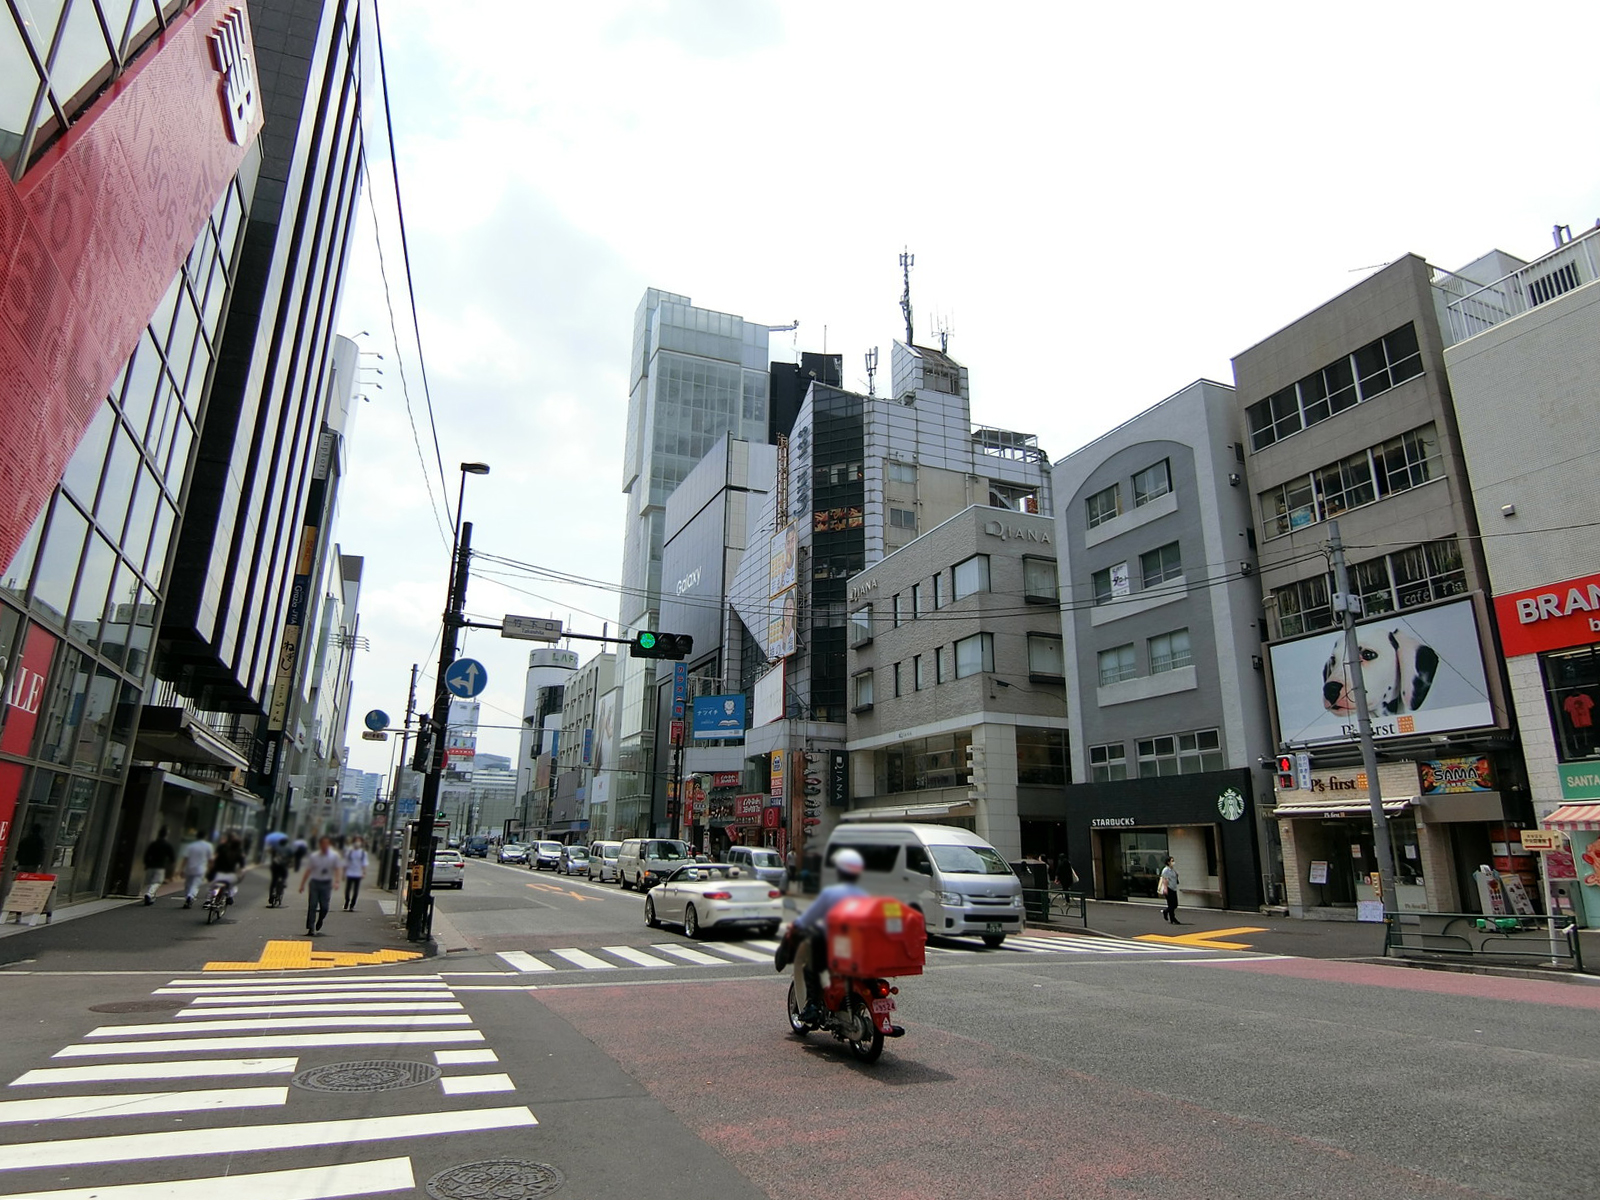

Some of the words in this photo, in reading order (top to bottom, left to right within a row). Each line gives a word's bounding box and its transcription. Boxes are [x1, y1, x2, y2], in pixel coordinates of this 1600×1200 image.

[985, 521, 1051, 544] DIANA
[676, 565, 702, 596] Galaxy
[1433, 766, 1478, 781] SAMA
[1091, 817, 1135, 827] STARBUCKS
